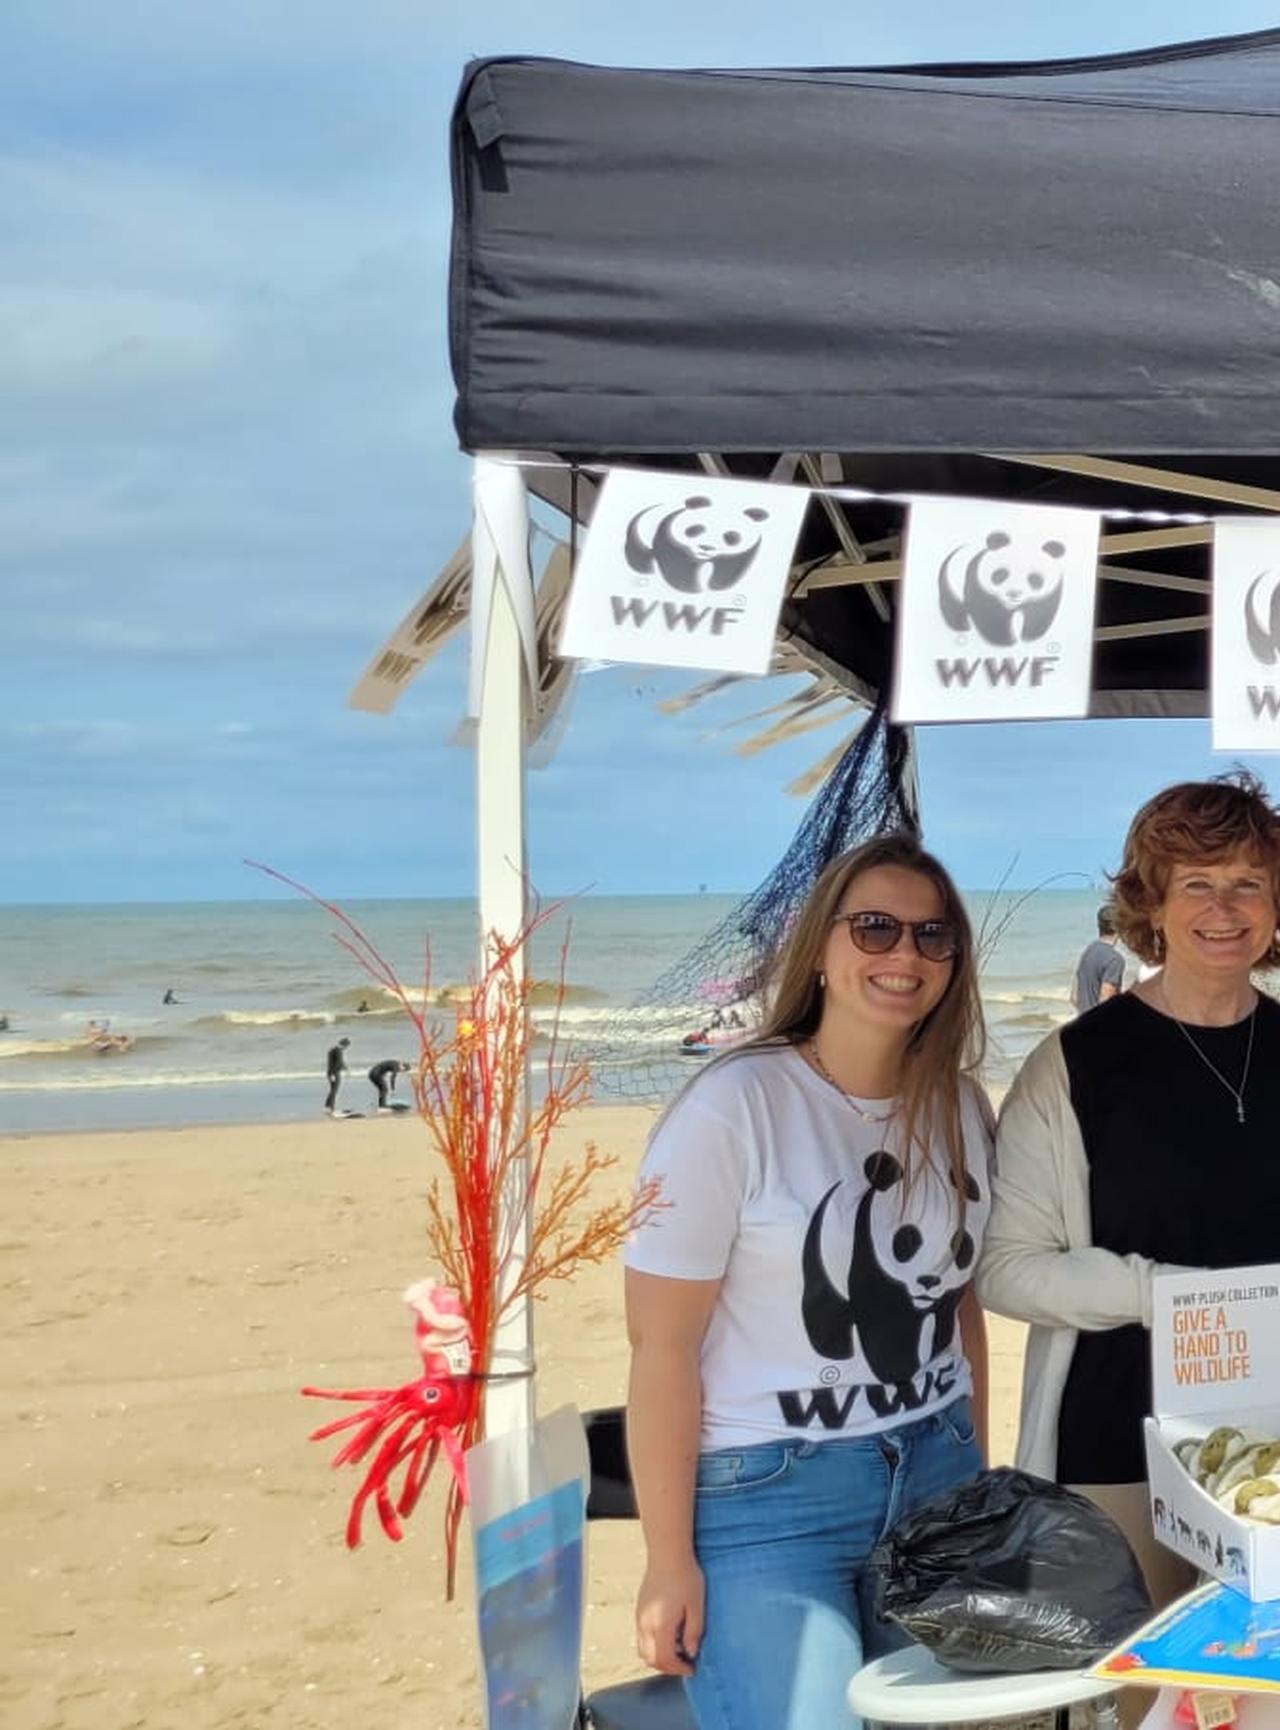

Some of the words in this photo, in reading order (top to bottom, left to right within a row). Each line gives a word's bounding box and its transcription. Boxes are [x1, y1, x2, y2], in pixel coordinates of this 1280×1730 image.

[609, 596, 745, 636] WWF
[936, 654, 1060, 690] WWF
[1173, 1293, 1196, 1307] WWF
[1228, 1285, 1279, 1302] COLLECTION
[1173, 1308, 1211, 1334] GIVE
[1216, 1306, 1227, 1330] A
[1173, 1332, 1220, 1360] HAND
[1224, 1330, 1248, 1354] TO
[1174, 1356, 1251, 1386] WILDLIFE
